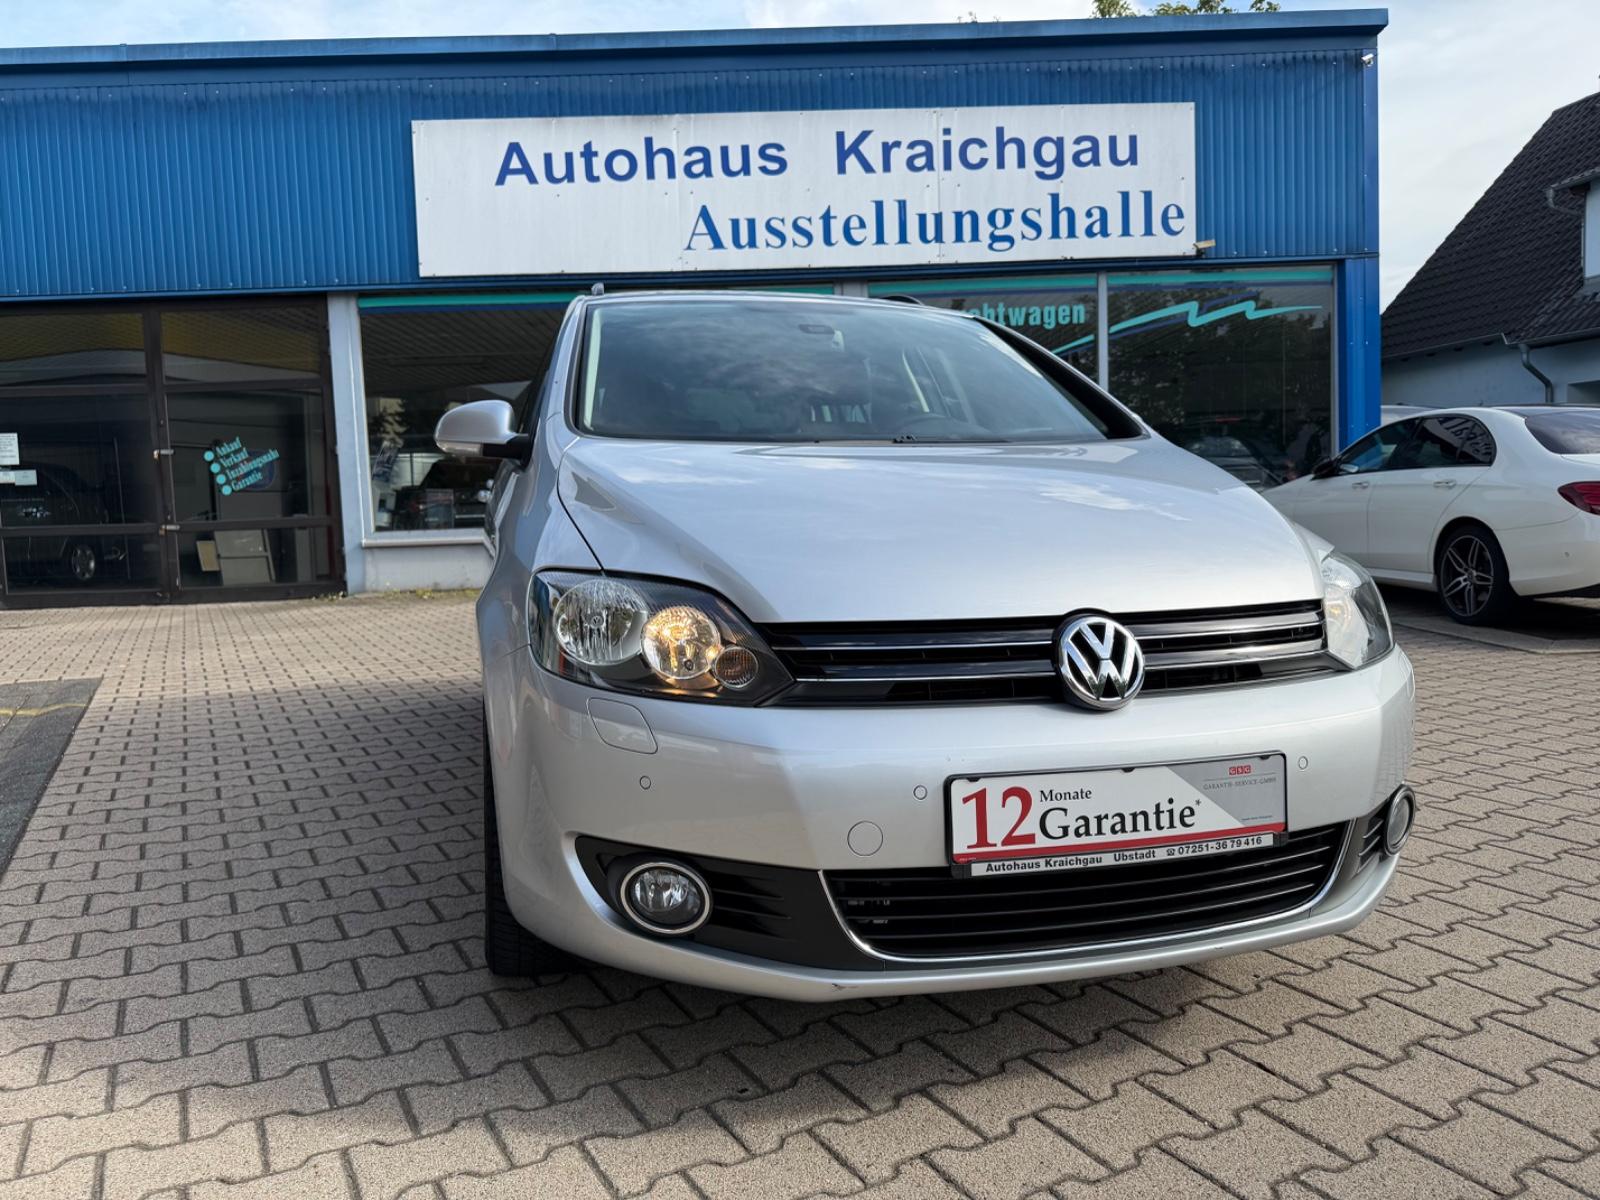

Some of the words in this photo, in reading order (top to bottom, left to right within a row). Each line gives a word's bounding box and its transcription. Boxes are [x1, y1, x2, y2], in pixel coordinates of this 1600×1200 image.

[495, 136, 788, 186] Autohaus
[835, 126, 1139, 181] Kraichgau
[683, 190, 1186, 252] Ausstellungshalle
[962, 786, 1036, 849] 12
[1039, 788, 1092, 803] Monate
[985, 862, 1041, 873] Autohaus
[1044, 854, 1103, 868] Kraichgau
[1113, 849, 1156, 863] Ubstadt
